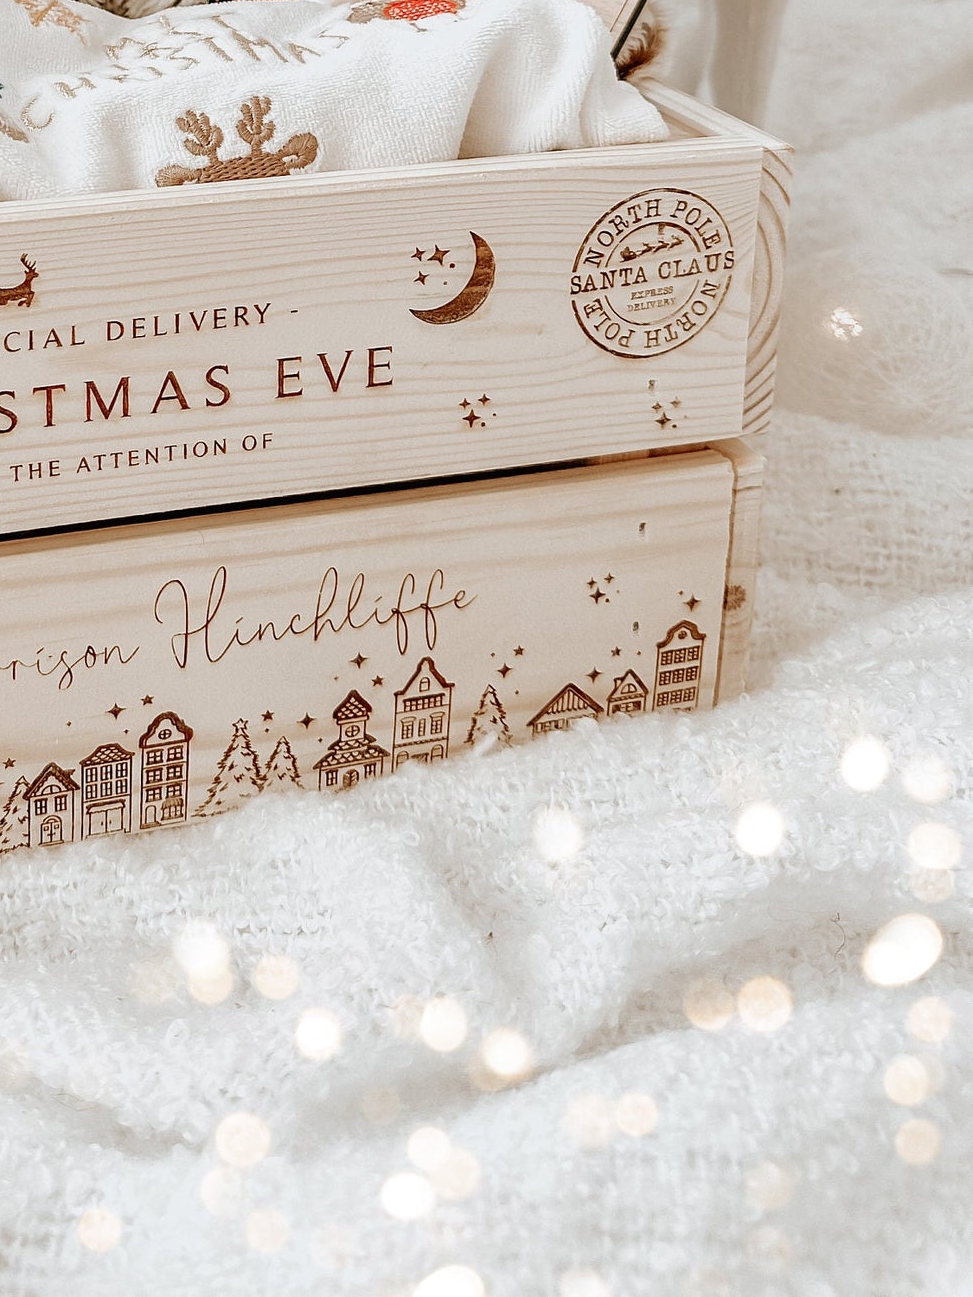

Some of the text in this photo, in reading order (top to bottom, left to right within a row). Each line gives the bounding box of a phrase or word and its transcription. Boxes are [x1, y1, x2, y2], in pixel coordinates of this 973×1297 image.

[583, 198, 723, 269] NORTH POLE
[569, 250, 736, 295] SANTA CLAUS
[630, 285, 675, 301] EXPRESS
[105, 302, 274, 343] DELIVERY
[583, 279, 722, 349] NORTH POLE
[627, 297, 677, 312] DELIVERY
[273, 344, 397, 400] EVE
[9, 457, 62, 482] THE
[75, 437, 230, 474] ATTENTION
[241, 431, 275, 452] OF
[153, 564, 479, 668] Hinchliffe
